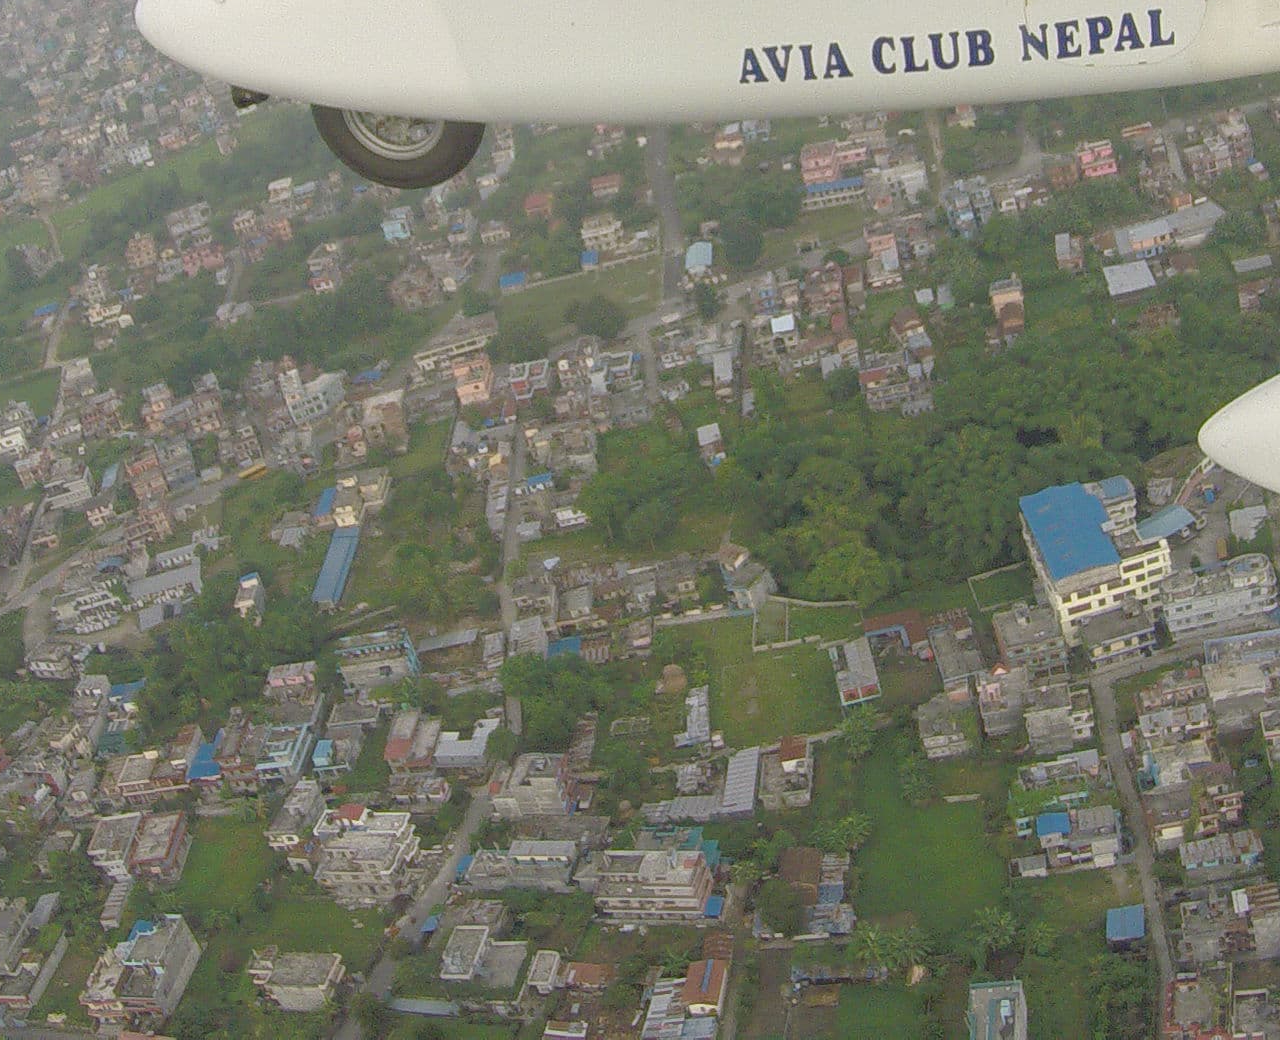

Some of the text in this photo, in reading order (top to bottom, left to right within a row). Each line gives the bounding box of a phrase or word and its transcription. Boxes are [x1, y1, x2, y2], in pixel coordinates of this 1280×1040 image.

[740, 9, 1174, 84] AVIA CLUB NEPAL
